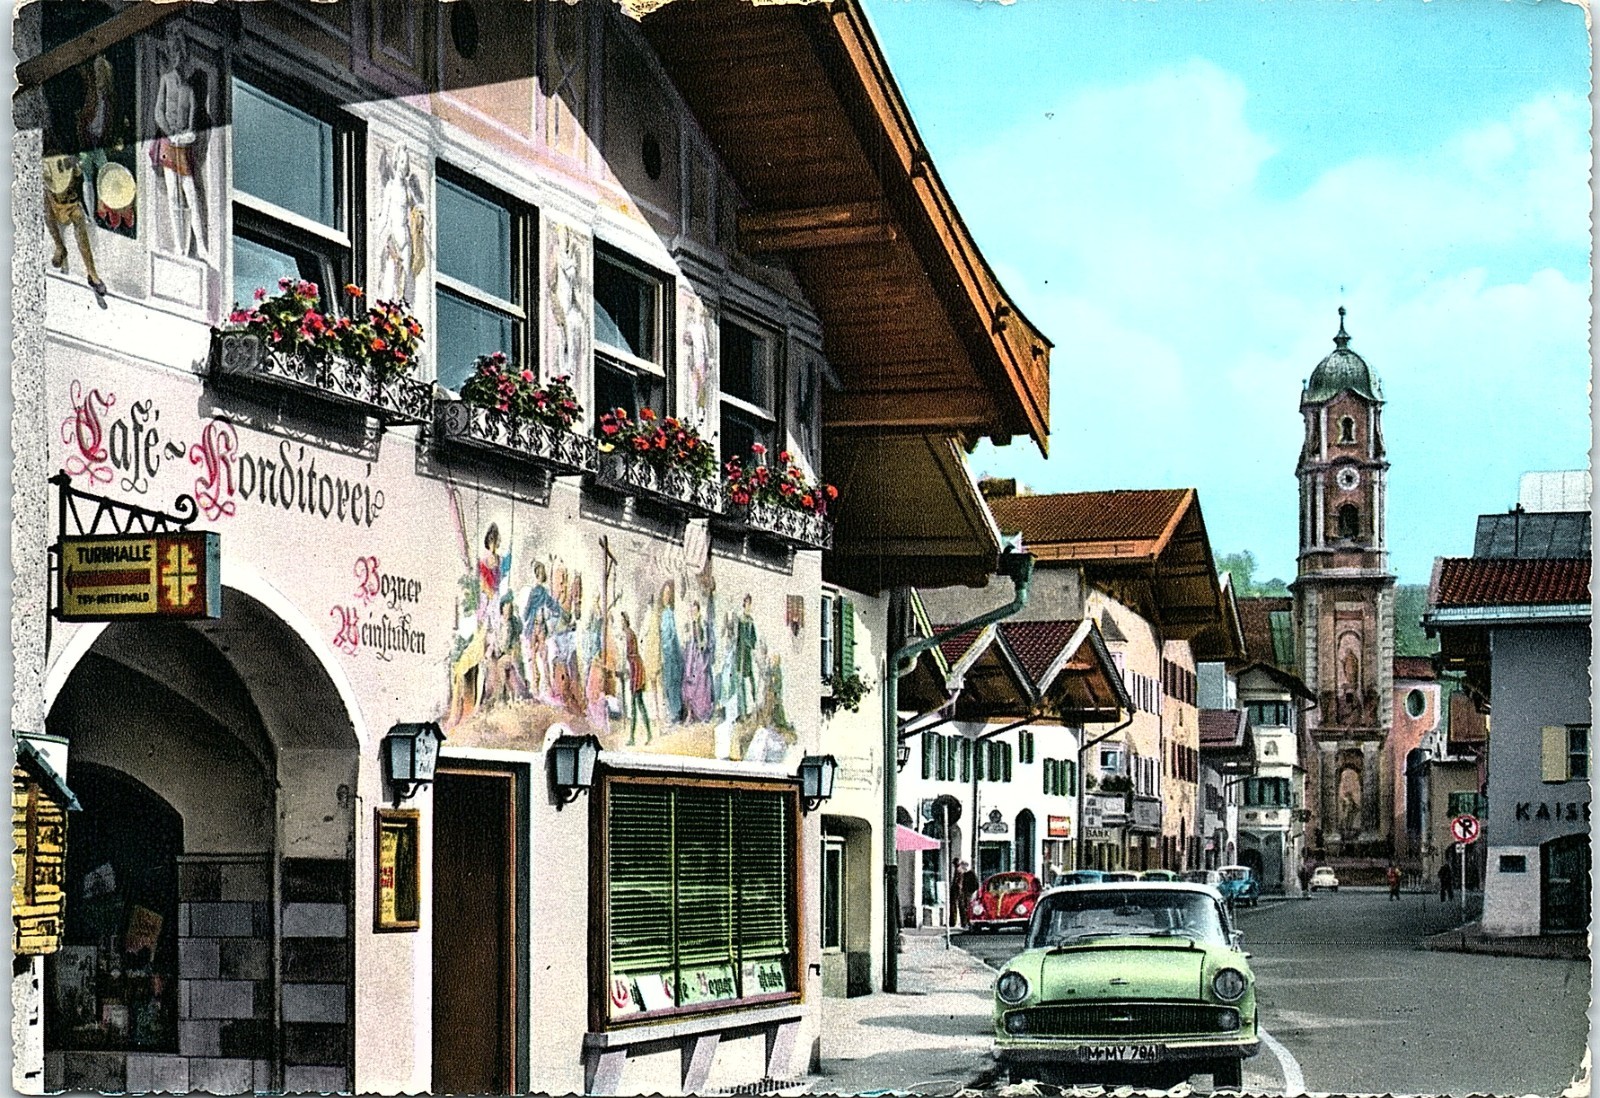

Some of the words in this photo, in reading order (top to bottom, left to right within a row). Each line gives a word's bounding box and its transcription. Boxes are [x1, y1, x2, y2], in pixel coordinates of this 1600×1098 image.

[189, 416, 385, 527] Konditorei
[77, 545, 152, 564] TURNHALLE
[354, 556, 422, 611] Bozner
[1085, 828, 1111, 839] BANK
